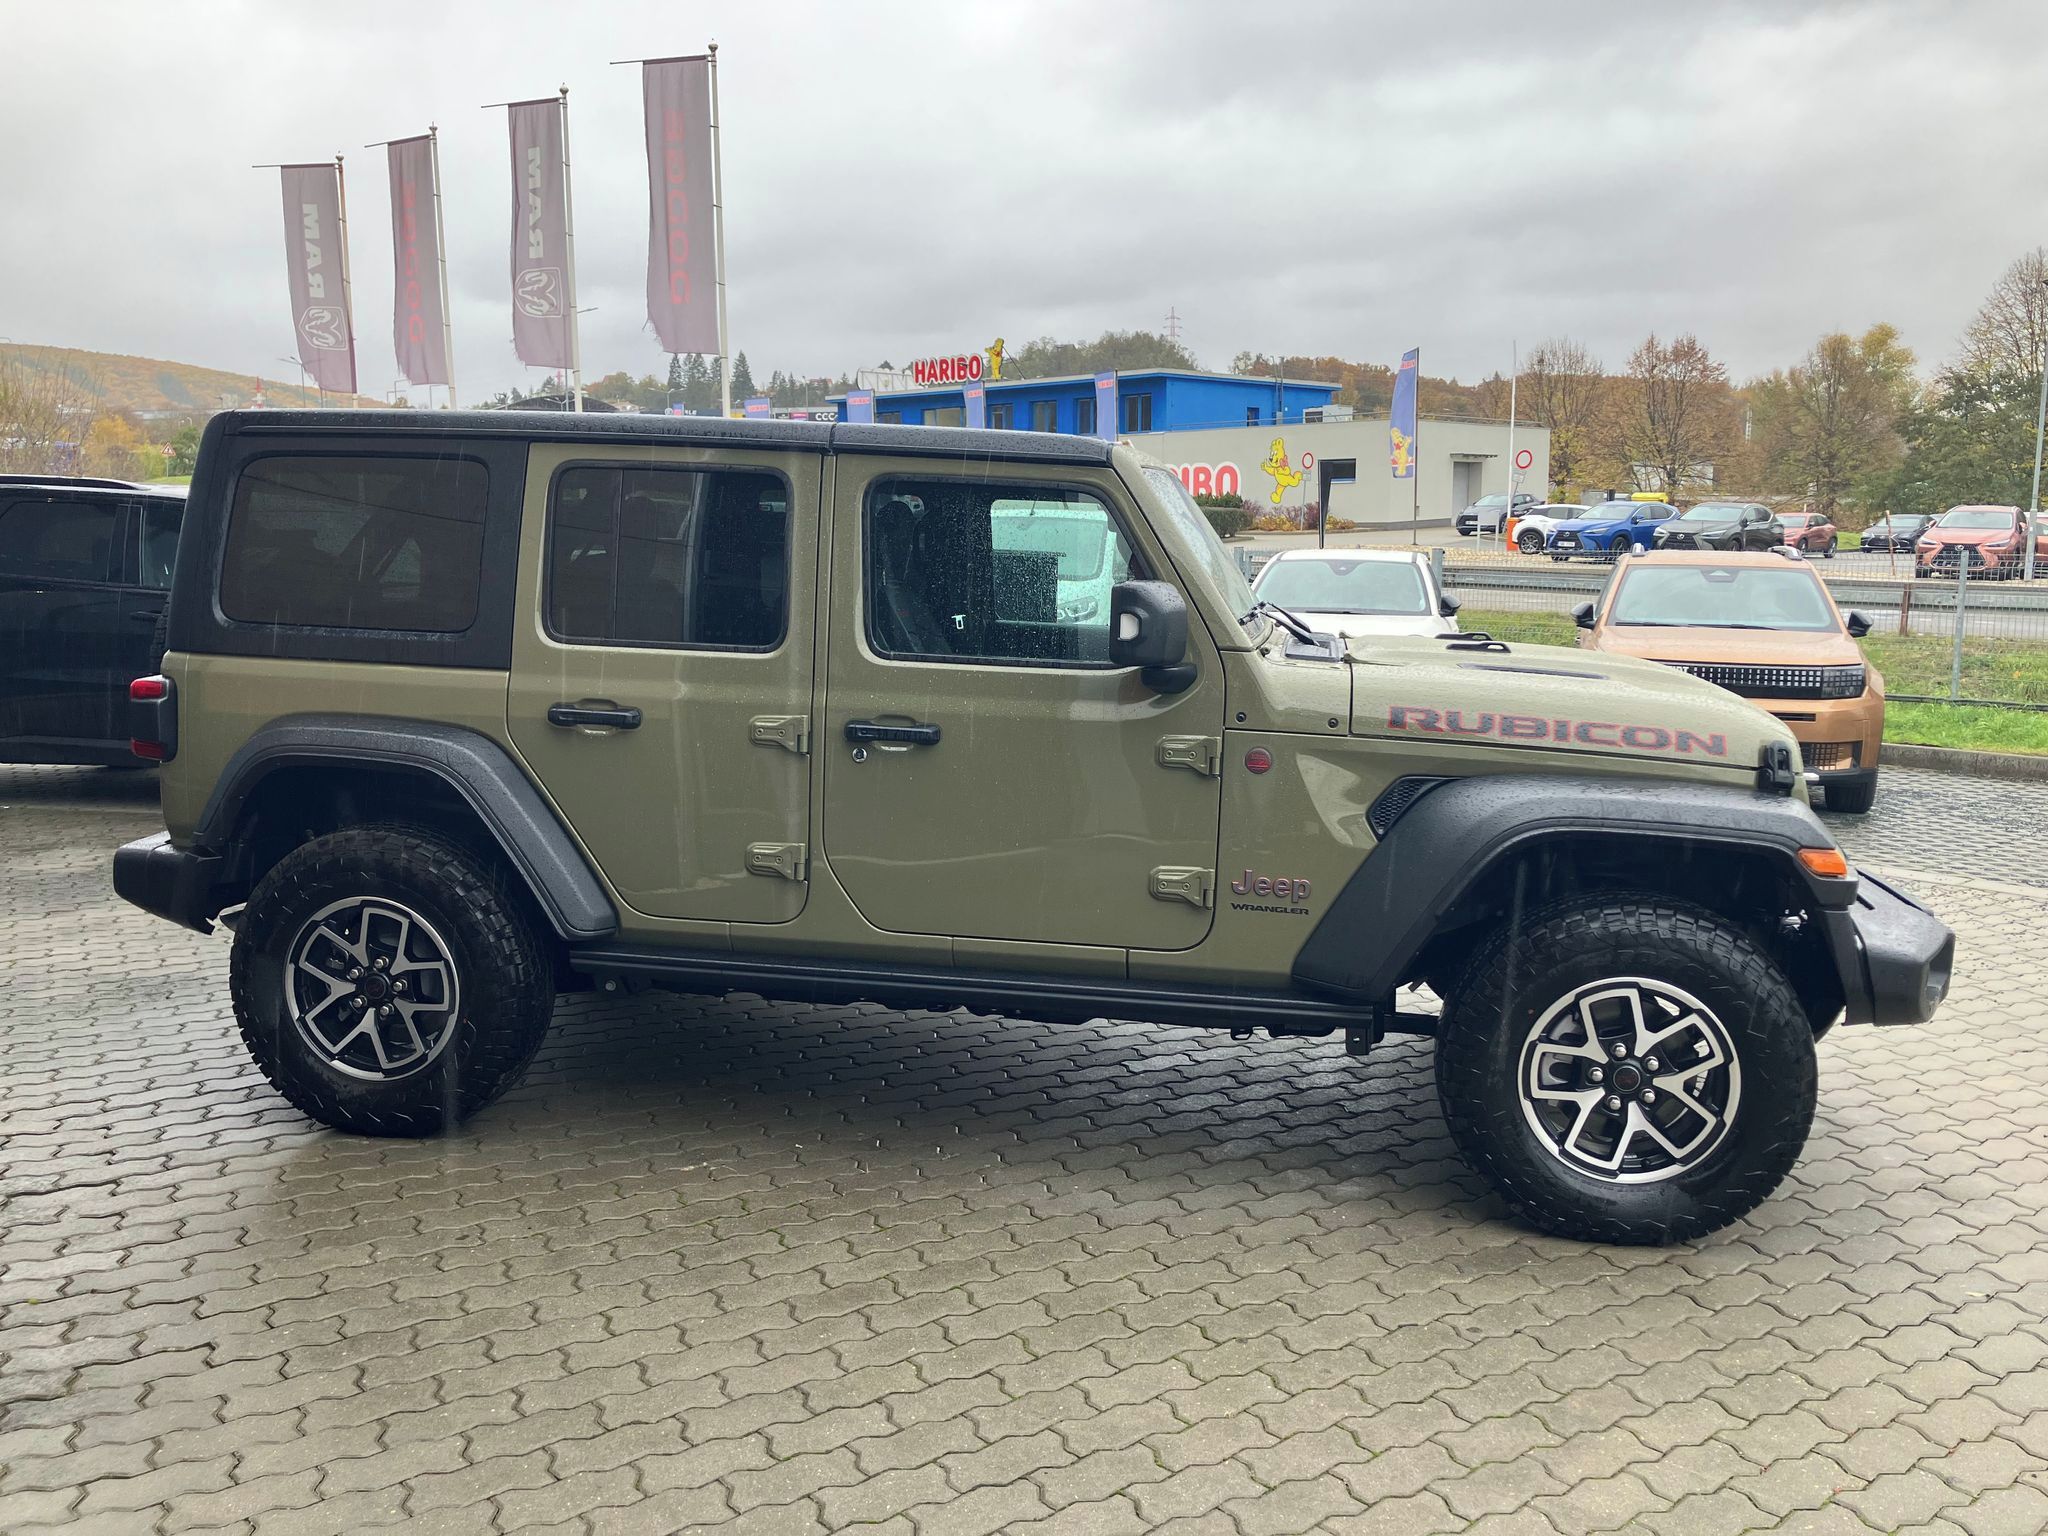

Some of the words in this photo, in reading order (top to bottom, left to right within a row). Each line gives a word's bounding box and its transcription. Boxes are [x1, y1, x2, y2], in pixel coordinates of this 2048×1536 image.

[914, 354, 981, 385] HARIBO
[1171, 465, 1239, 497] IBO
[1387, 705, 1727, 757] RUBICON
[1232, 869, 1312, 903] Jeep
[1231, 902, 1310, 915] WRANGLER
